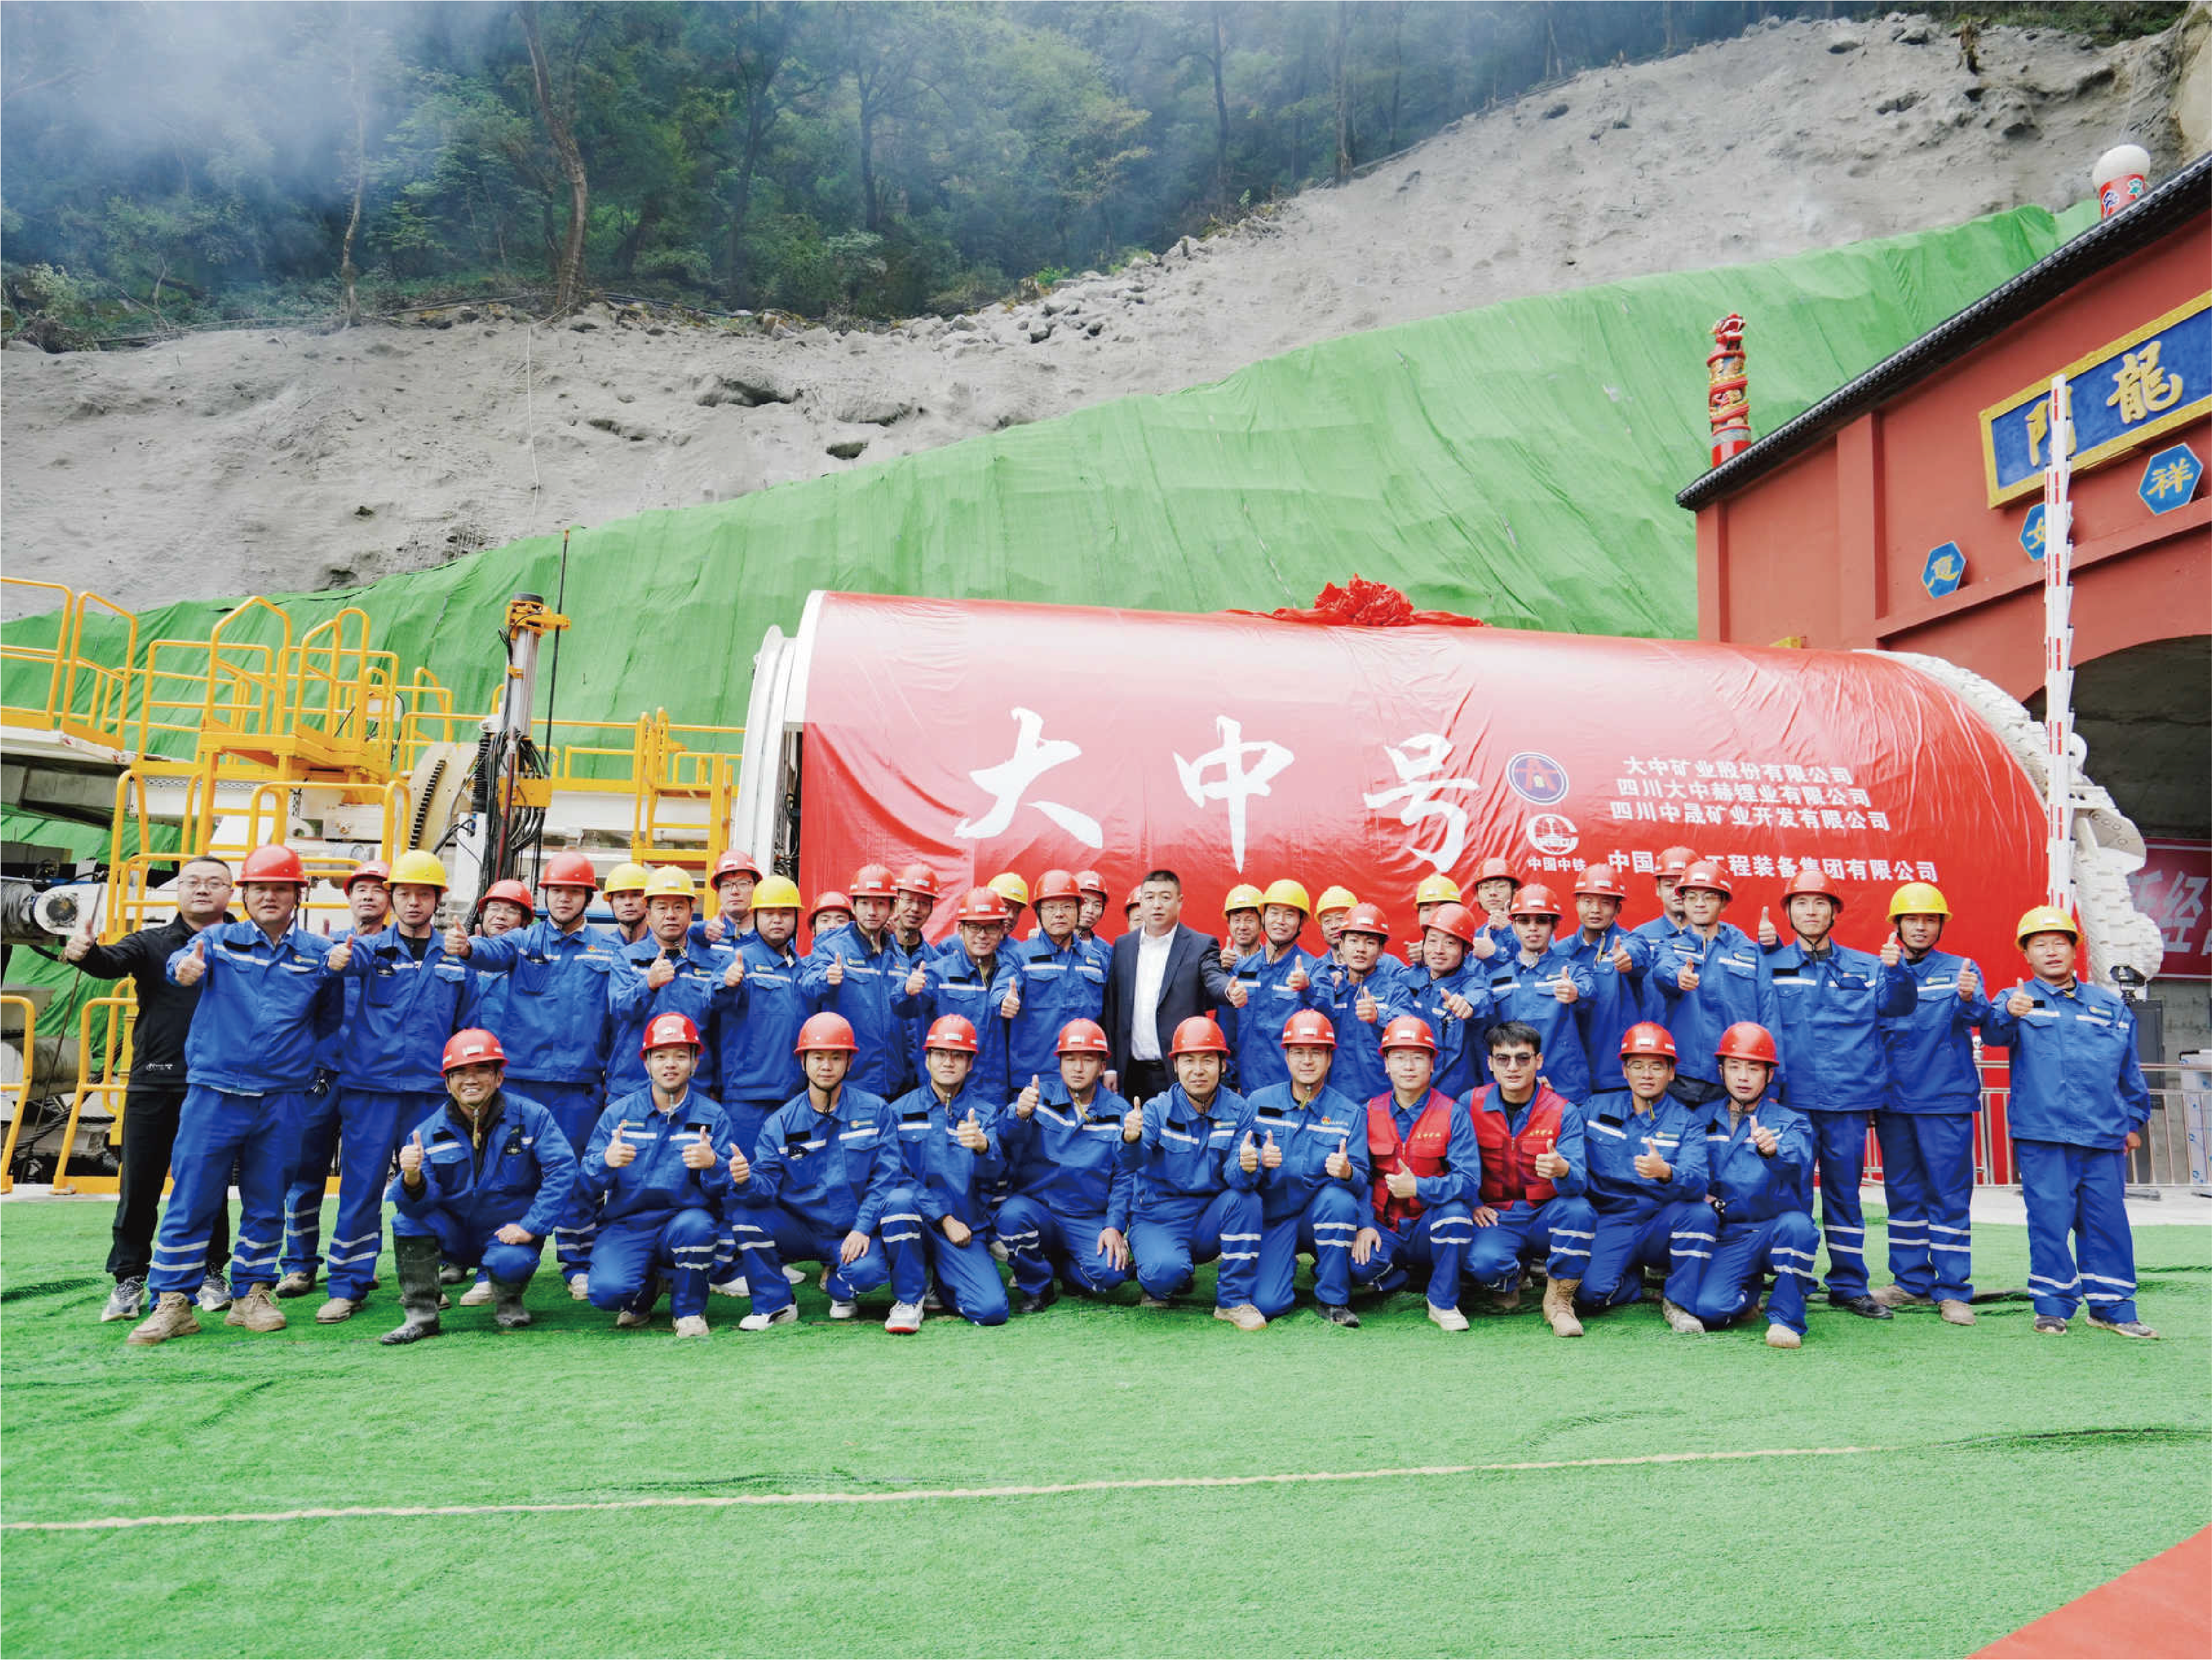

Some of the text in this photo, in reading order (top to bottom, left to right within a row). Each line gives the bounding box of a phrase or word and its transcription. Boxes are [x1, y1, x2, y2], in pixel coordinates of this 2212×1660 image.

[2147, 457, 2194, 499] 祥
[1622, 756, 1853, 785] 大中矿业股份有限公司
[953, 706, 1479, 874] 大中号
[1617, 778, 1872, 808] 四川大中赫锂业有限公司
[1610, 802, 1891, 831] 四川中晟矿业开发有限公司
[1526, 856, 1585, 872] 中国中铁
